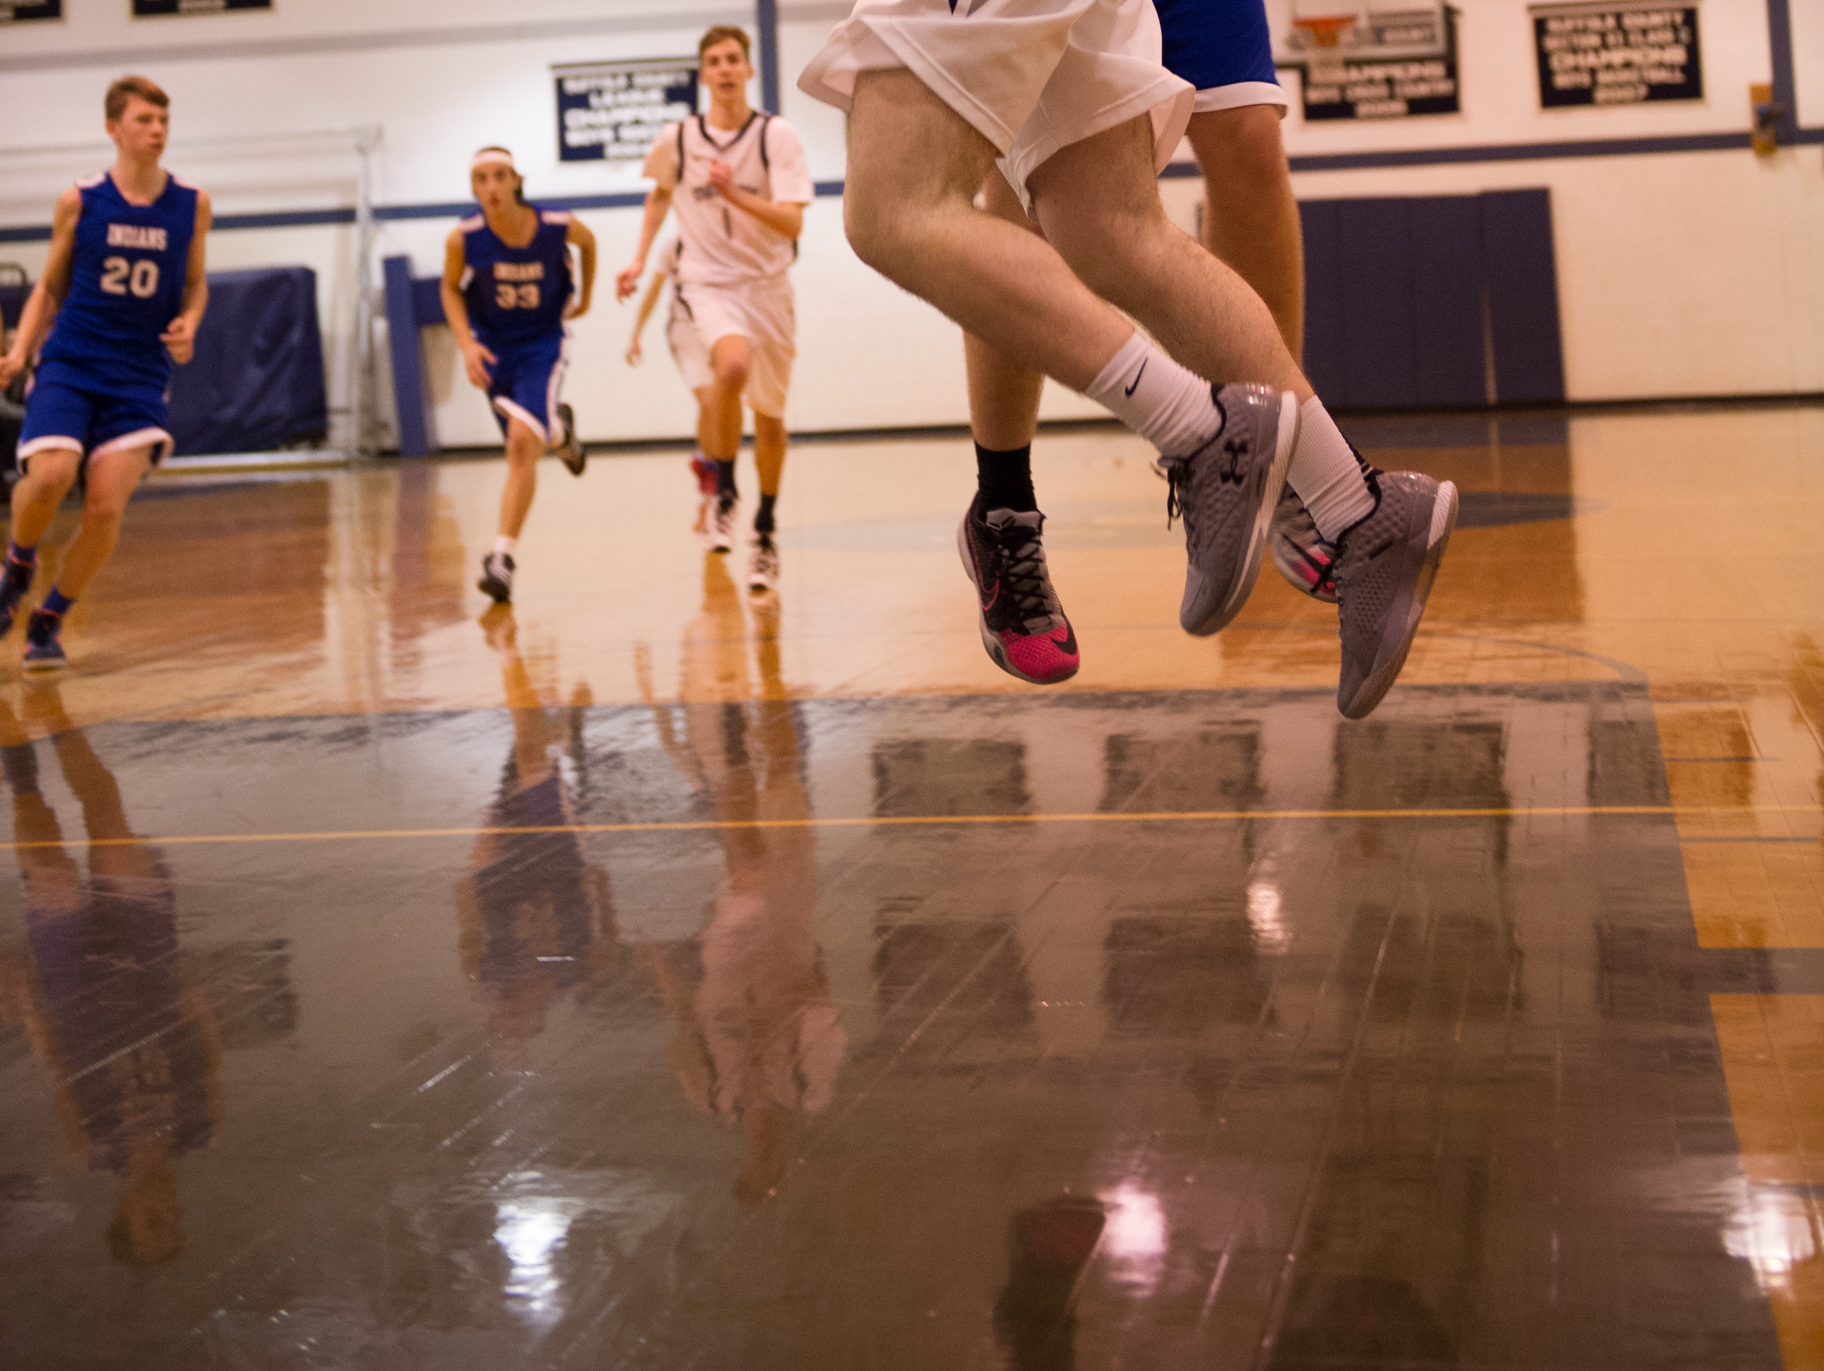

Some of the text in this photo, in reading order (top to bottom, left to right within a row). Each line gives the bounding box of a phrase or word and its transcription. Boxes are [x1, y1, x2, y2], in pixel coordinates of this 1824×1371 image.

[1549, 44, 1688, 72] CHAMPIONS
[100, 255, 159, 299] 20
[495, 283, 541, 310] 33
